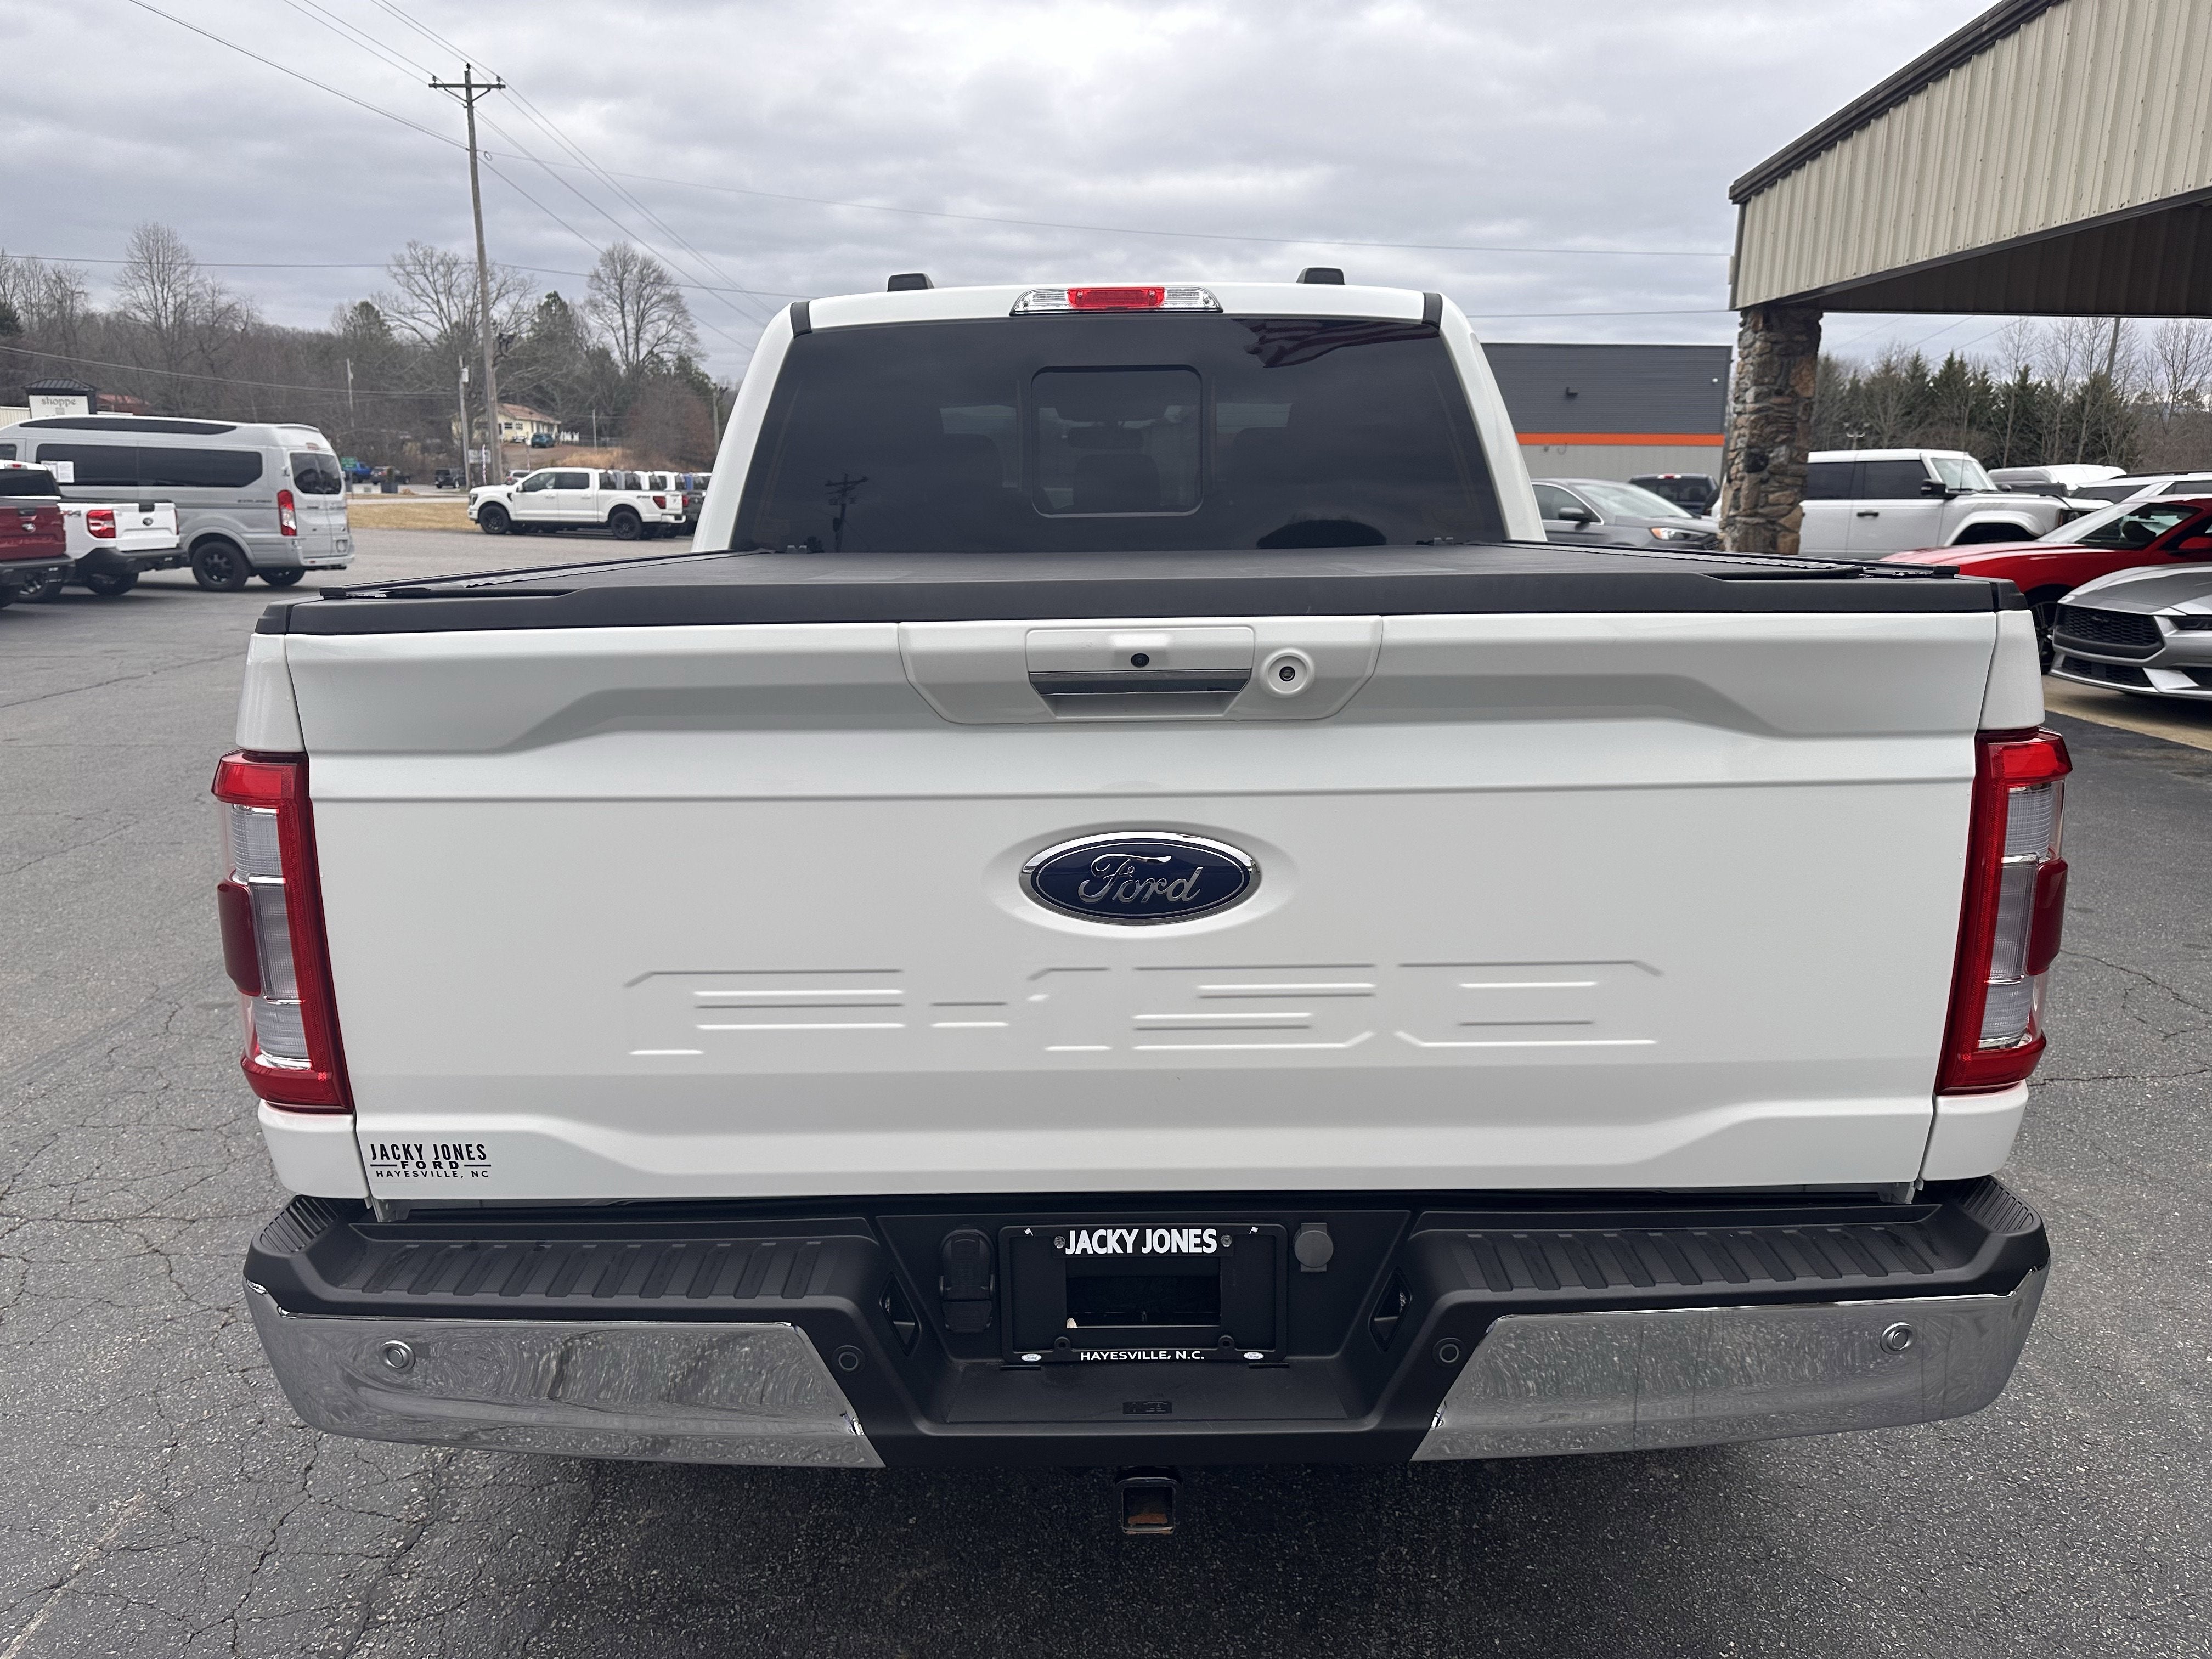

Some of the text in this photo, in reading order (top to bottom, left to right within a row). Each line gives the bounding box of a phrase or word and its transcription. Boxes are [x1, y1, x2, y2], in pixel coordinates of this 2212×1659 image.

[42, 397, 76, 408] shoppe
[1077, 853, 1204, 903] Ford
[623, 960, 1664, 1056] F-150
[370, 1144, 487, 1160] JACKY JONES
[400, 1160, 459, 1169] FORD
[1065, 1228, 1217, 1255] JACKY JONES
[1080, 1351, 1205, 1361] HAYESVILLE, N.C.
